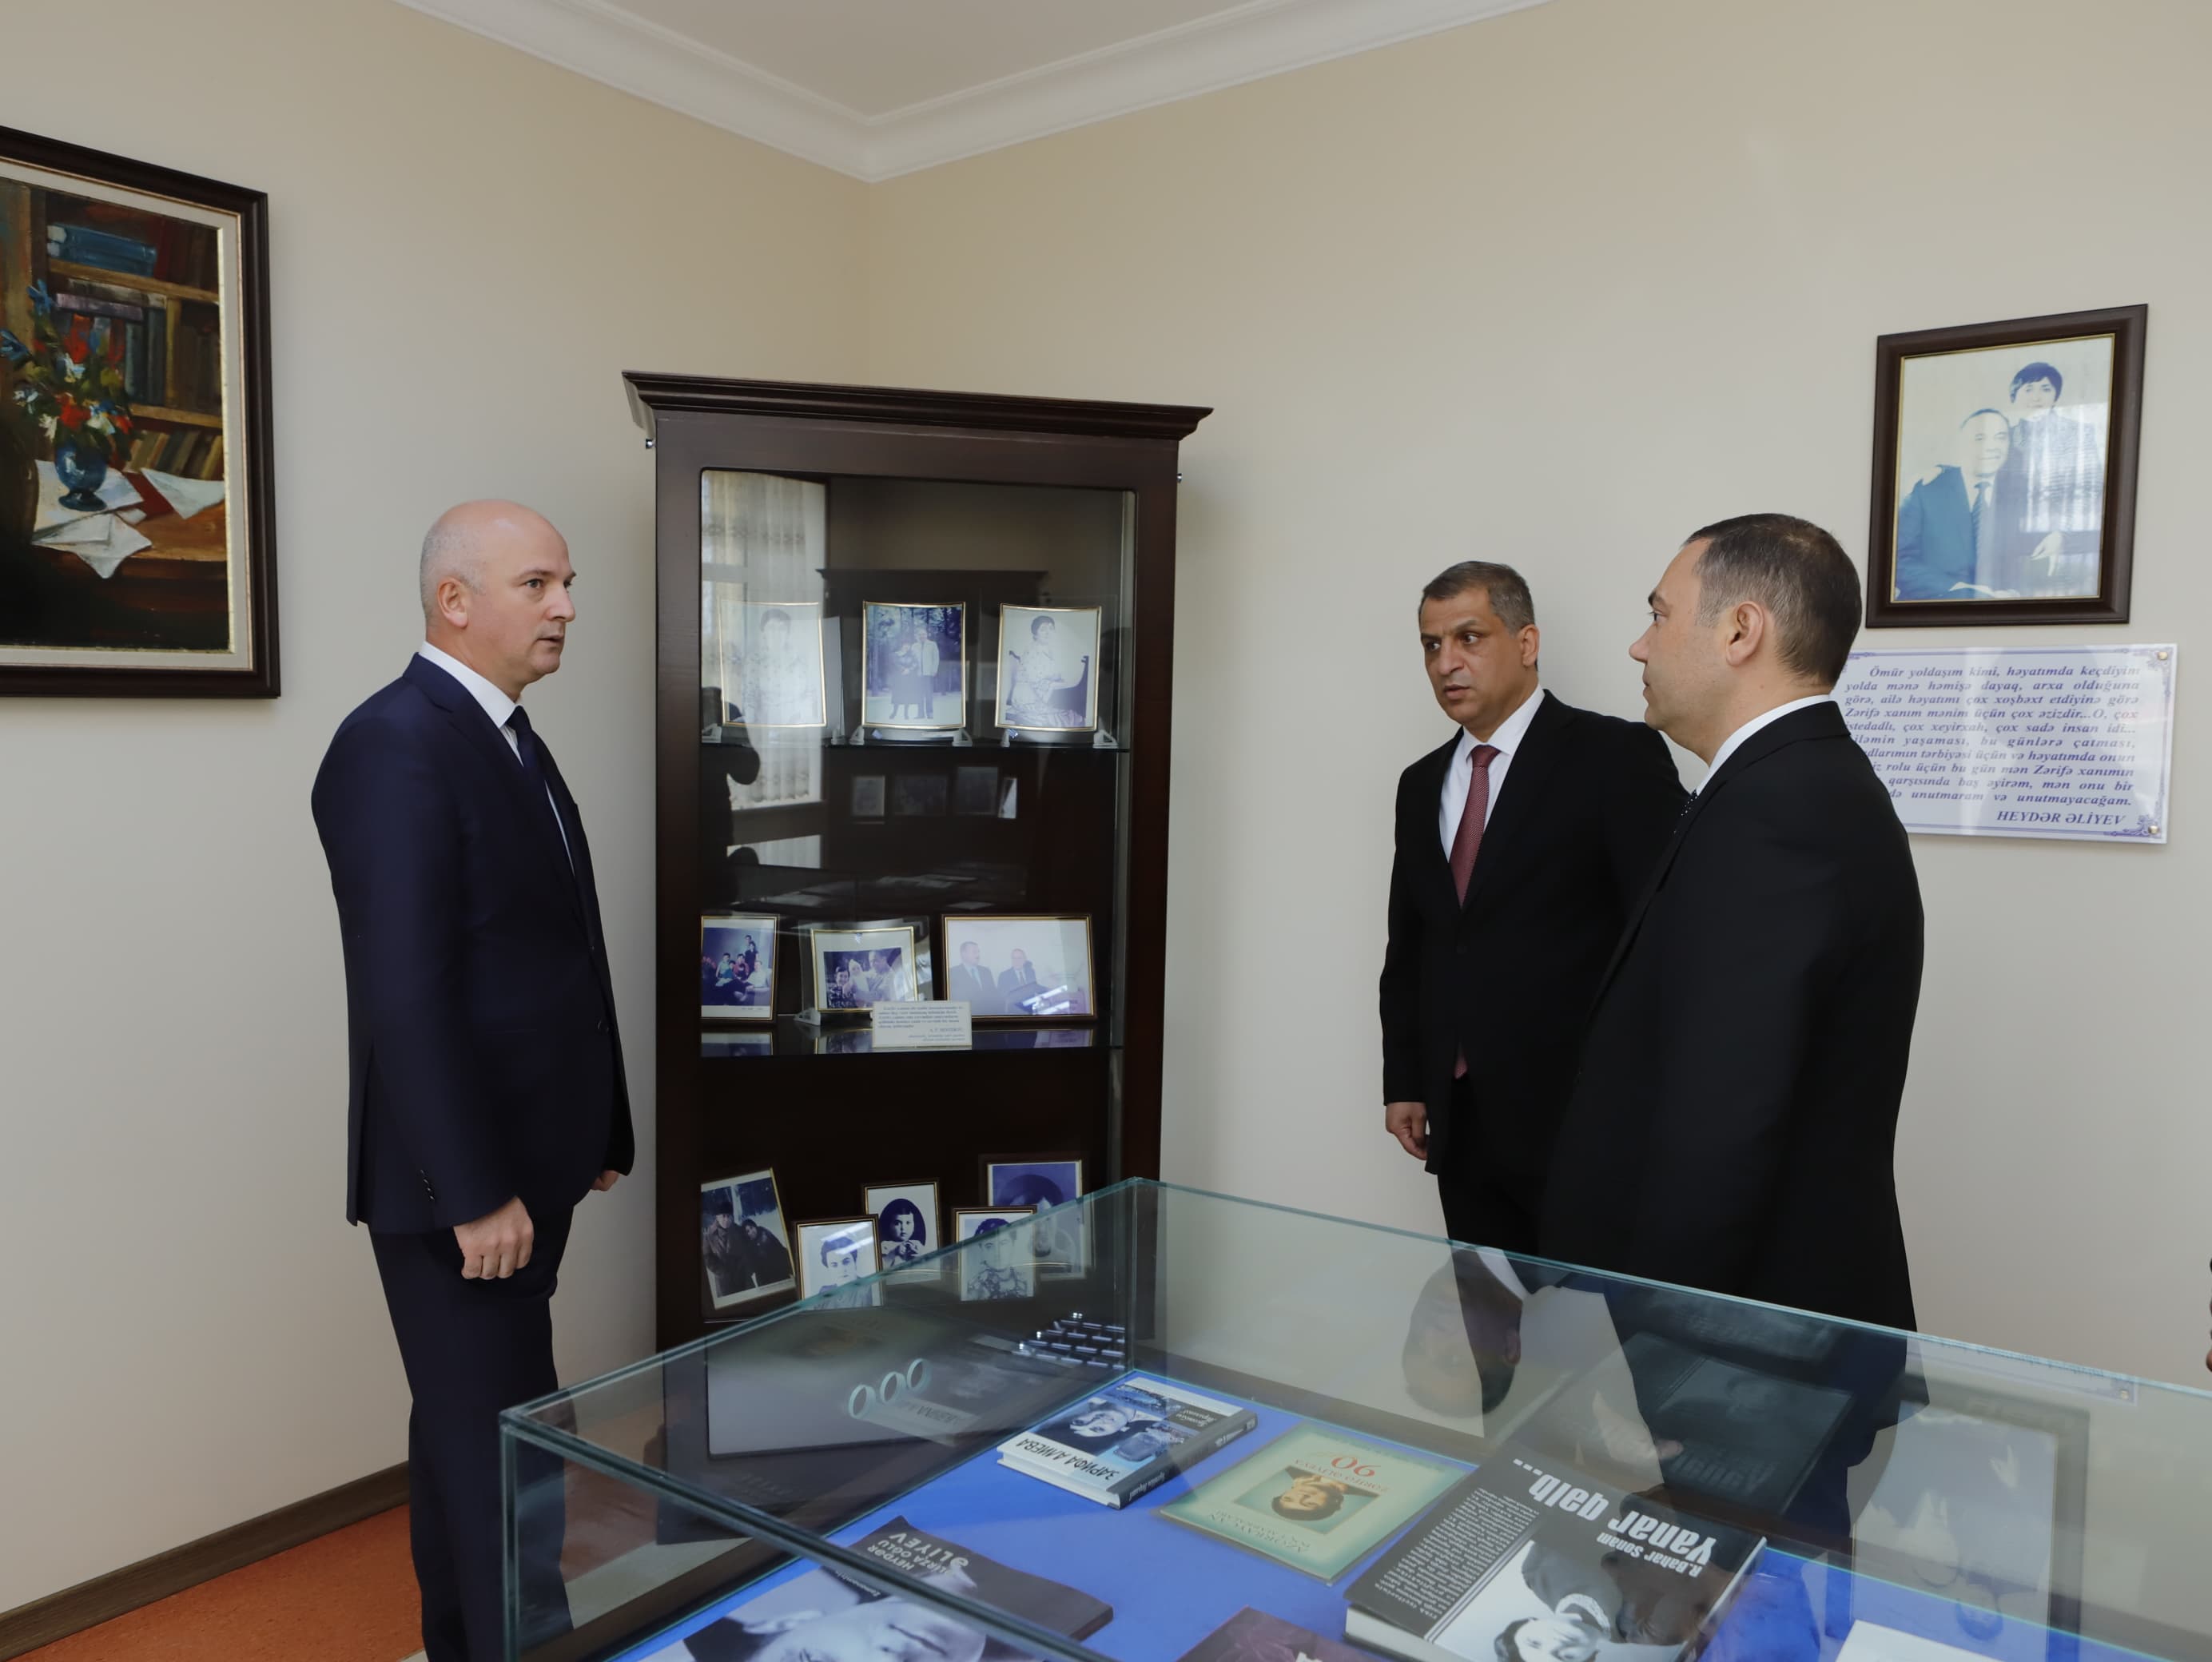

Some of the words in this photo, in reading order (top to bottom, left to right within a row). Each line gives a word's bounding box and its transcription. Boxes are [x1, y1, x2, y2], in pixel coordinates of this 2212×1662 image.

[1870, 666, 1904, 677] Ömür
[1908, 667, 1963, 679] yoldaşım
[1969, 666, 2000, 677] kimi,
[2007, 666, 2073, 678] həyatımda
[1845, 682, 1878, 692] yolda
[1982, 681, 2022, 692] dayaq,
[2073, 681, 2139, 692] olduğuna
[1845, 695, 1874, 706] görə,
[1908, 695, 1959, 706] həyatımı
[1995, 694, 2043, 706] xoşbəxt
[2050, 694, 2101, 706] etdiyinə
[2107, 695, 2139, 706] görə
[1845, 708, 1880, 719] Zərifə
[1975, 710, 2006, 719] üçün
[2011, 710, 2033, 719] çox
[2115, 710, 2138, 719] çox
[1931, 722, 1988, 734] xeyirxah,
[1996, 724, 2019, 734] çox
[2026, 723, 2054, 732] sadə
[2063, 723, 2099, 733] insan
[1903, 737, 1969, 746] yaşaması,
[2007, 737, 2063, 748] günlərə
[2073, 739, 2135, 748] çatması,
[1921, 749, 1971, 761] tərbiyəsi
[1975, 751, 2007, 761] üçün
[2028, 751, 2095, 762] həyatımda
[1886, 762, 1911, 772] rolu
[1916, 764, 1946, 773] üçün
[1971, 765, 1995, 775] gün
[2033, 765, 2073, 777] Zərifə
[1888, 777, 1950, 787] qarşısında
[1959, 778, 1979, 788] baş
[1987, 778, 2033, 789] əyirəm,
[2115, 781, 2134, 791] bir
[1912, 791, 1983, 800] unutmaram
[2017, 794, 2131, 807] unutmayacağam.
[1996, 810, 2061, 823] HEYDƏR
[2065, 812, 2126, 825] ƏLİYEV
[1016, 1438, 1070, 1461] АЛИЕВА
[1064, 1455, 1119, 1480] ЗАРИФА
[1513, 1457, 1610, 1521] qəlb...
[1608, 1510, 1717, 1564] Yanar
[889, 1532, 969, 1568] ƏLİYEV
[1596, 1533, 1644, 1558] Sonam
[868, 1545, 915, 1571] HEYDƏR
